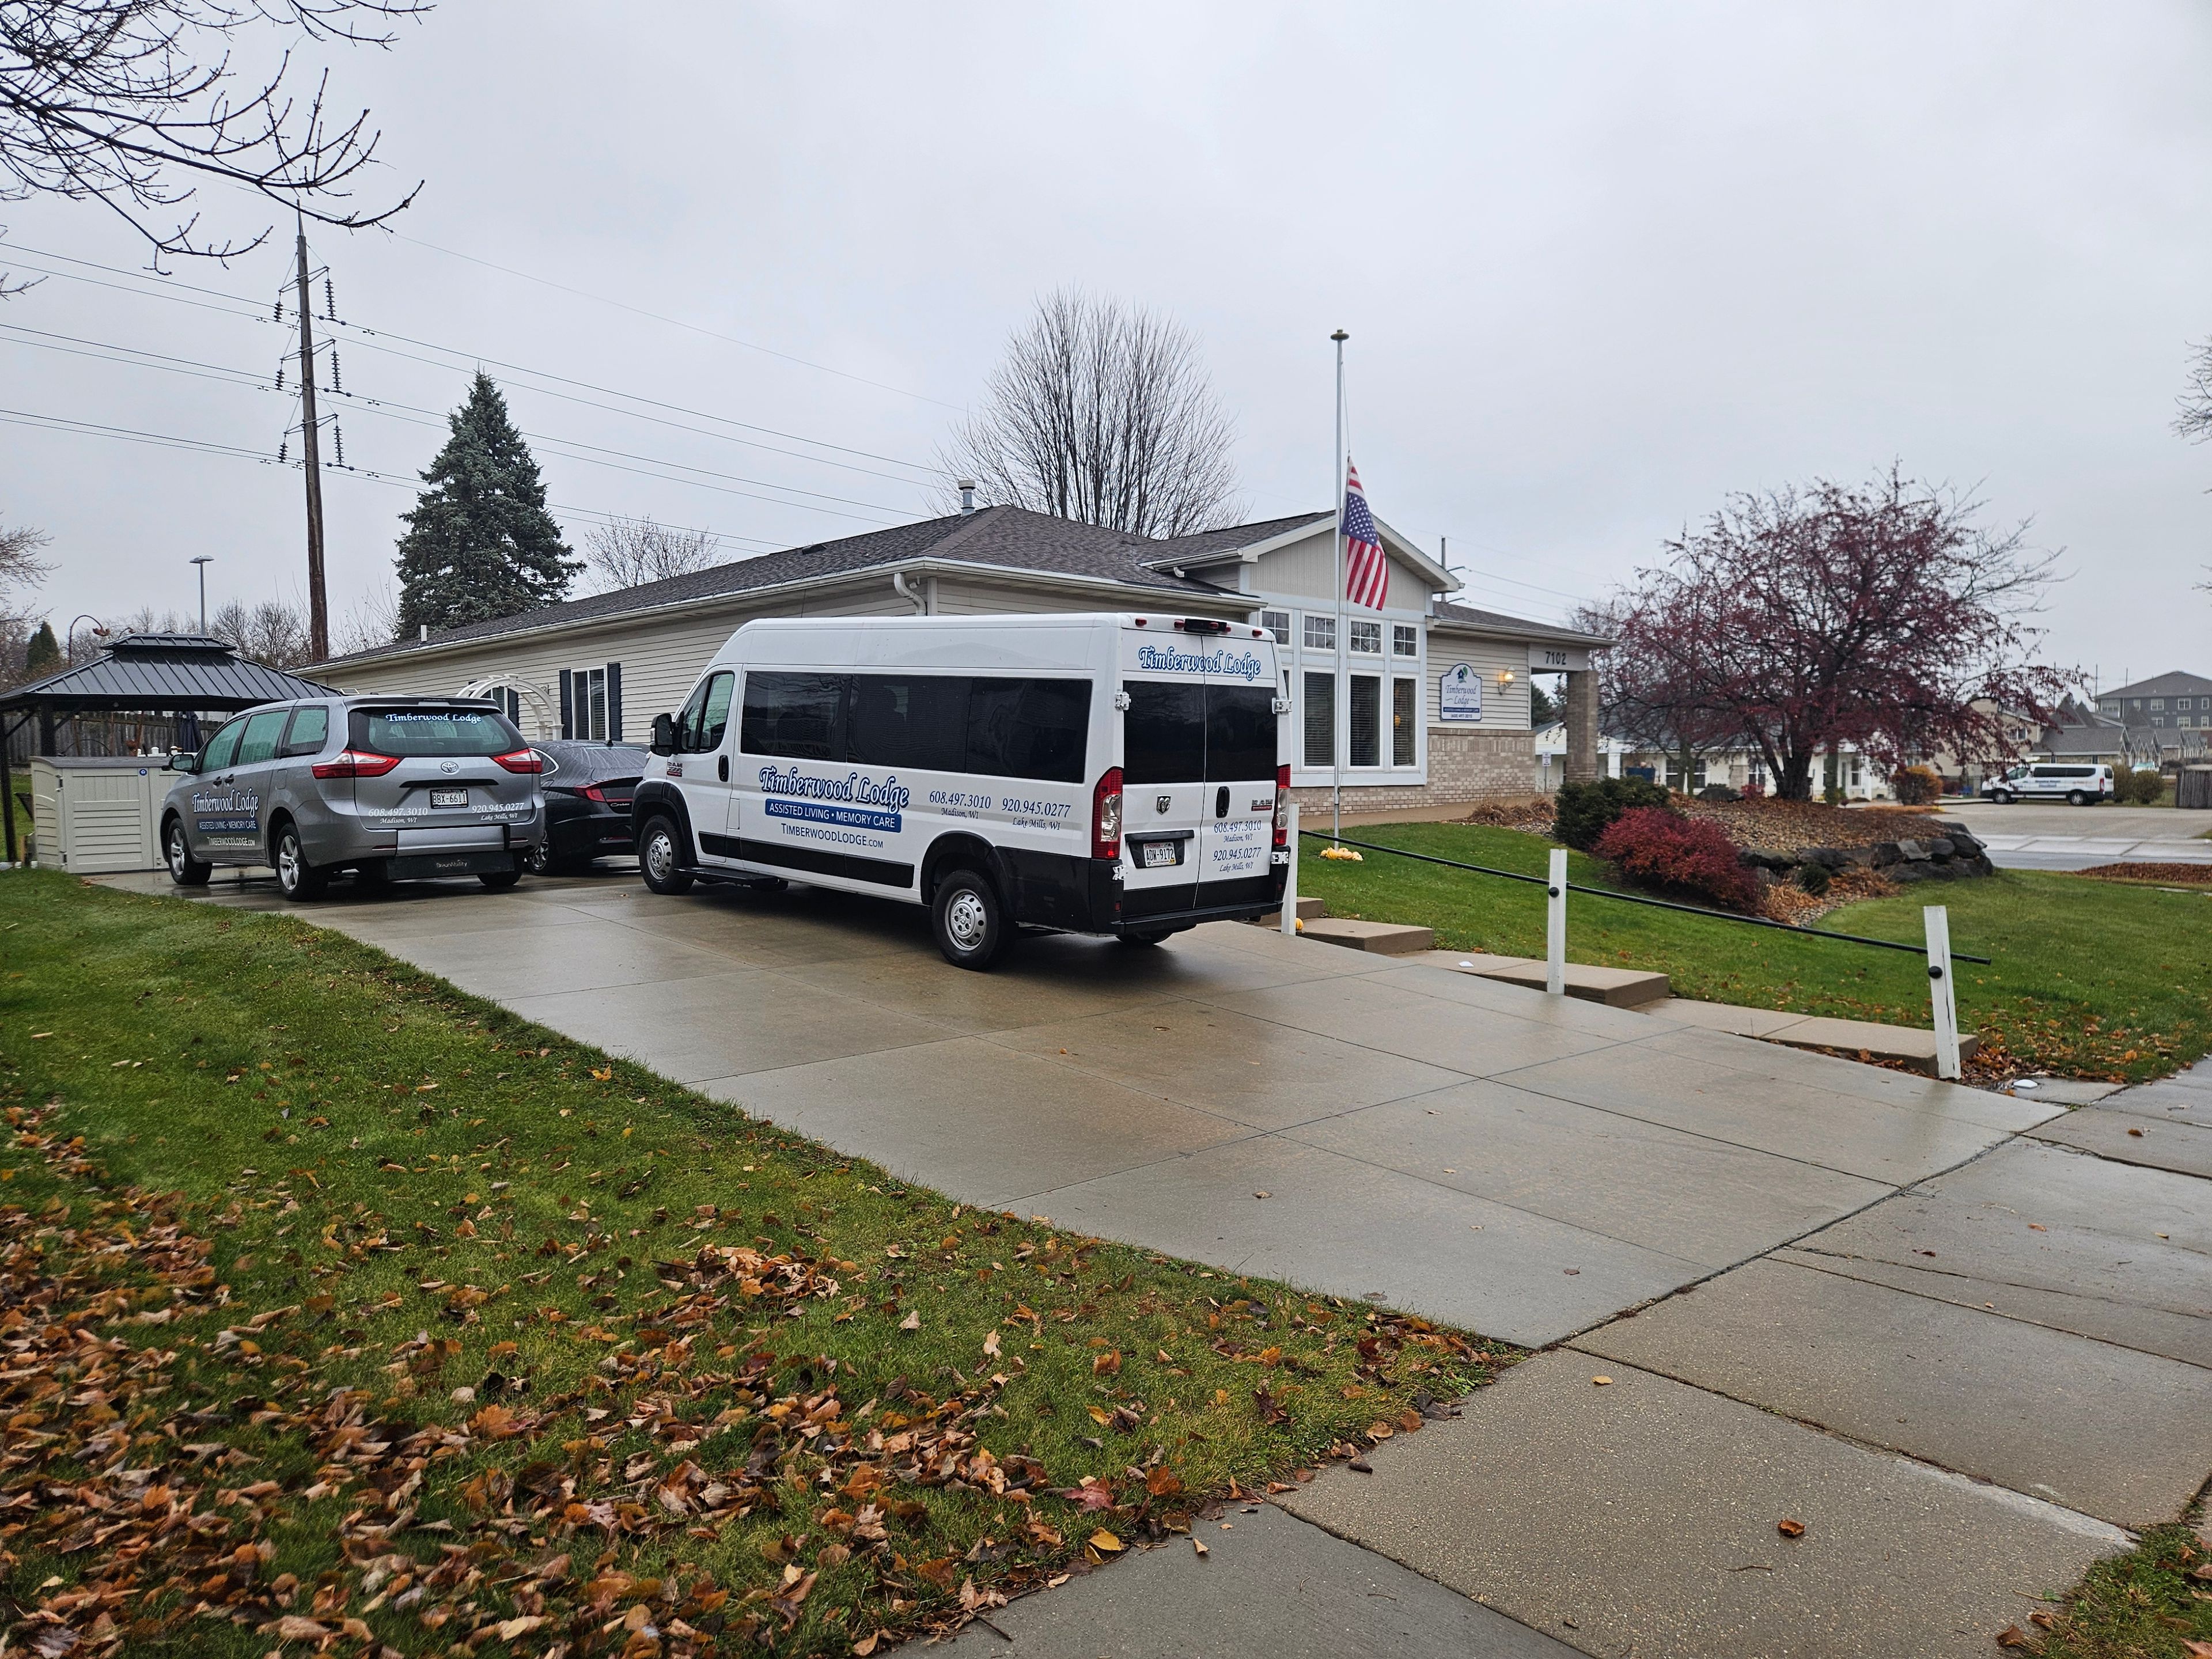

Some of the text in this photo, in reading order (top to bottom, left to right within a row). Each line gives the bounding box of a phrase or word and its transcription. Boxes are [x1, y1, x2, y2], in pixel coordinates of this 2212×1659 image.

[1138, 646, 1261, 681] Timberwood Lodge
[1546, 652, 1566, 665] 7102
[1445, 684, 1478, 694] Timberwood
[1454, 695, 1469, 707] Lodge
[385, 713, 482, 724] Timberwood Lodge
[760, 766, 910, 814] Timberwood Lodge
[192, 787, 259, 818] Timberwood Lodge
[433, 794, 466, 804] BBX-6611
[929, 790, 991, 809] 608.497.3010
[368, 807, 428, 817] 608.497.3010
[472, 802, 525, 814] 920.945.0277
[941, 808, 967, 819] Madison,
[1002, 798, 1071, 818] 920.945.0277
[769, 802, 895, 828] ASSISTED LIVING MEMORY CARE
[199, 820, 257, 830] ASSISTED LIVING MEMORY CARE
[1013, 817, 1061, 831] Lake Mills, WI
[1214, 820, 1262, 834] 608.497.3010
[1224, 833, 1253, 843] Madison, WI
[1213, 847, 1262, 861] 920.945.0277
[1219, 863, 1231, 873] Lake
[1245, 861, 1253, 869] WI
